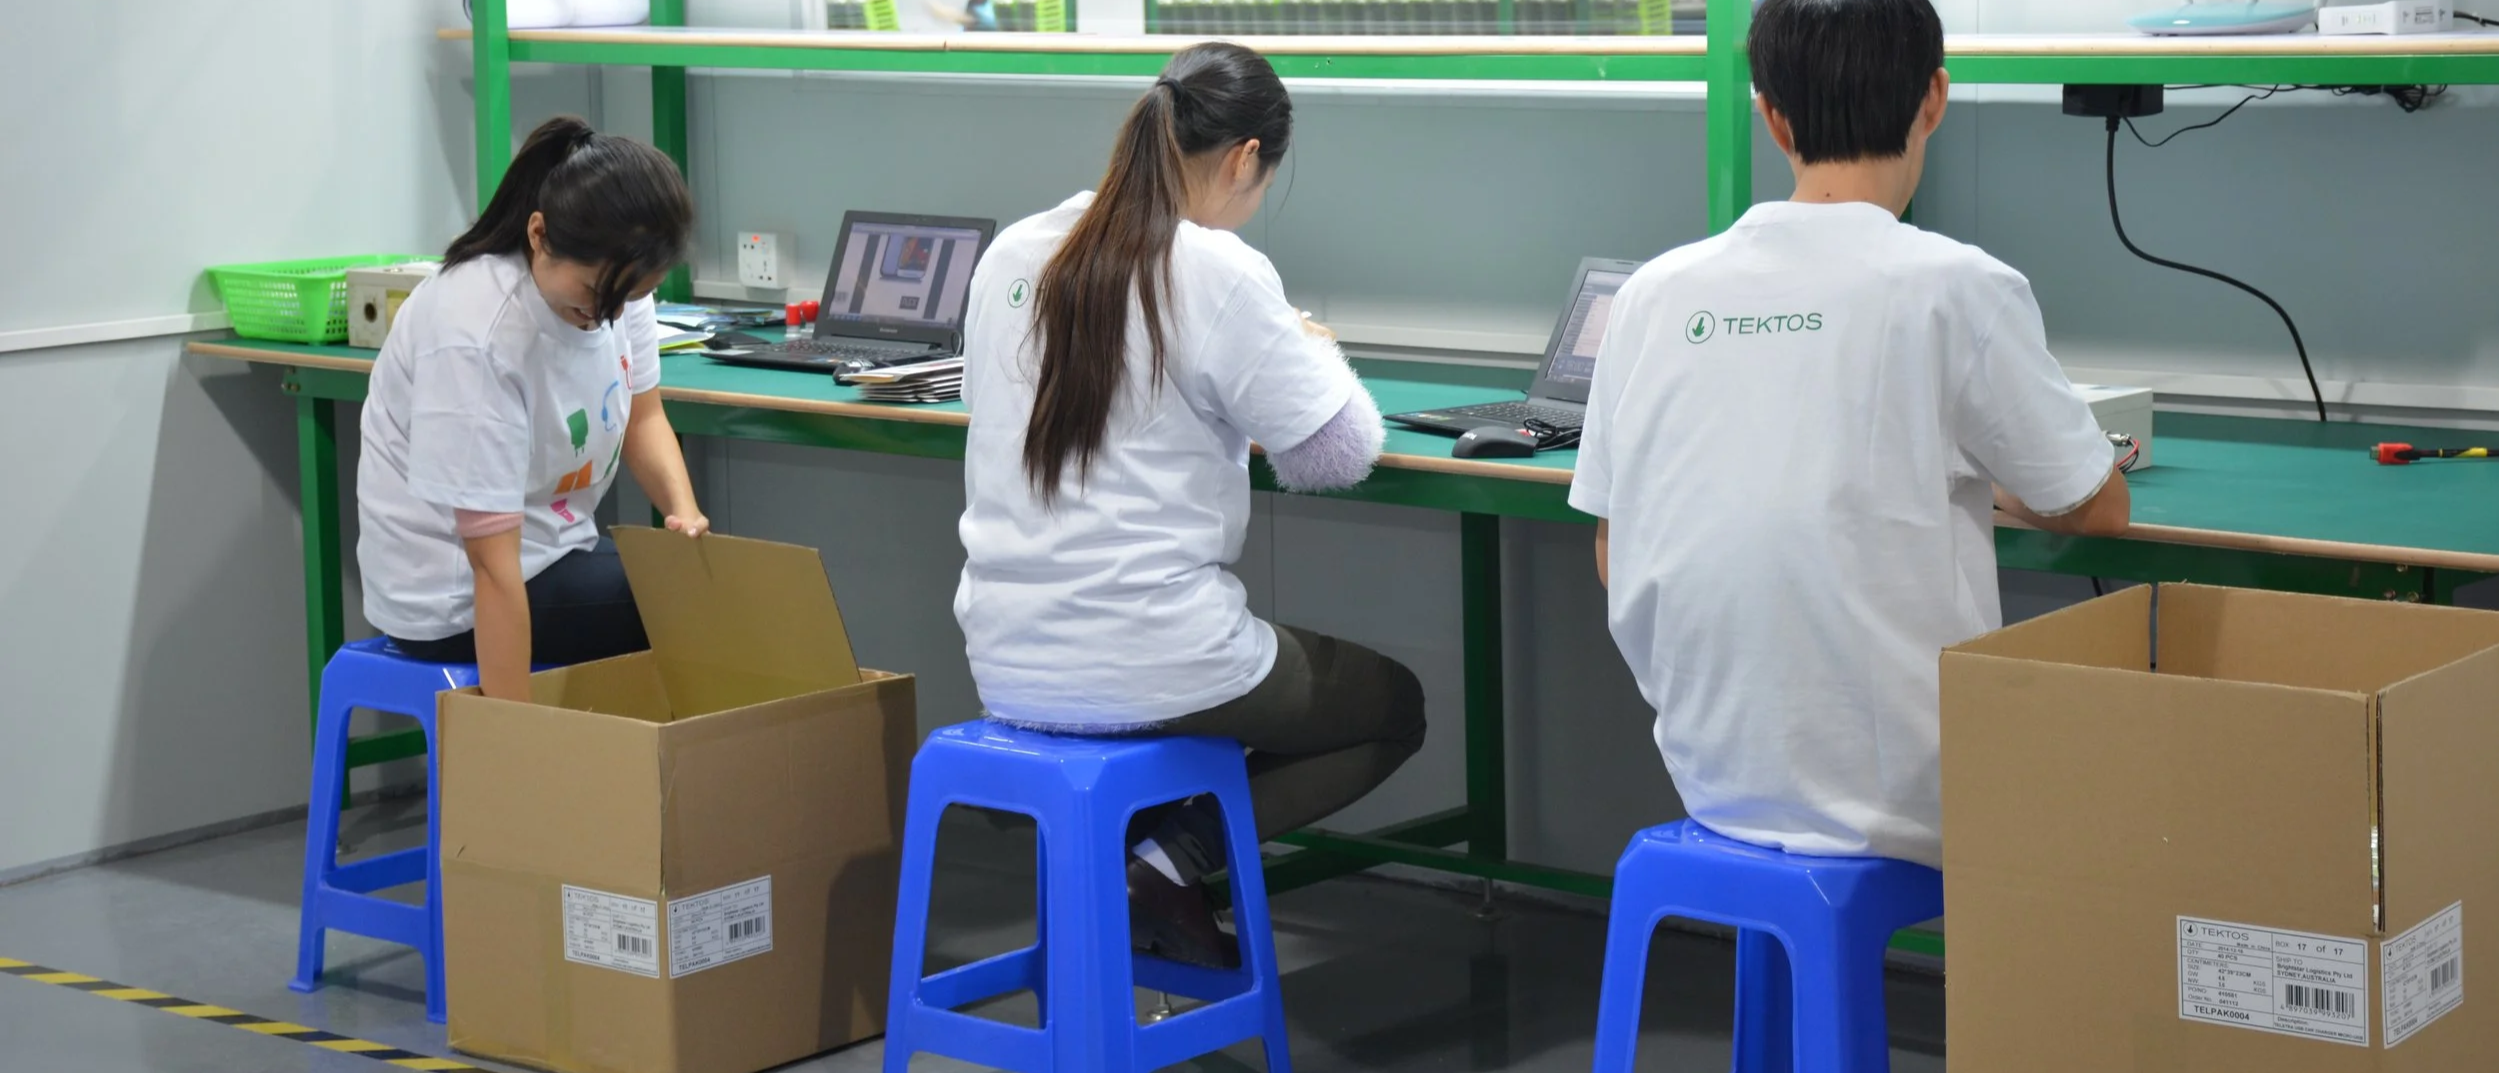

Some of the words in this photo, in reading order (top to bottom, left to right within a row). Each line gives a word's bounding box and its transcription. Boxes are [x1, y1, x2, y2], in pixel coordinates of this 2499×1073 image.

[1723, 312, 1823, 335] TEKTOS
[2201, 926, 2250, 941] TEKTOS
[2297, 943, 2307, 951] 17
[2316, 945, 2326, 953] of
[2334, 948, 2344, 956] 17
[2194, 1005, 2250, 1020] TELPAK0004
